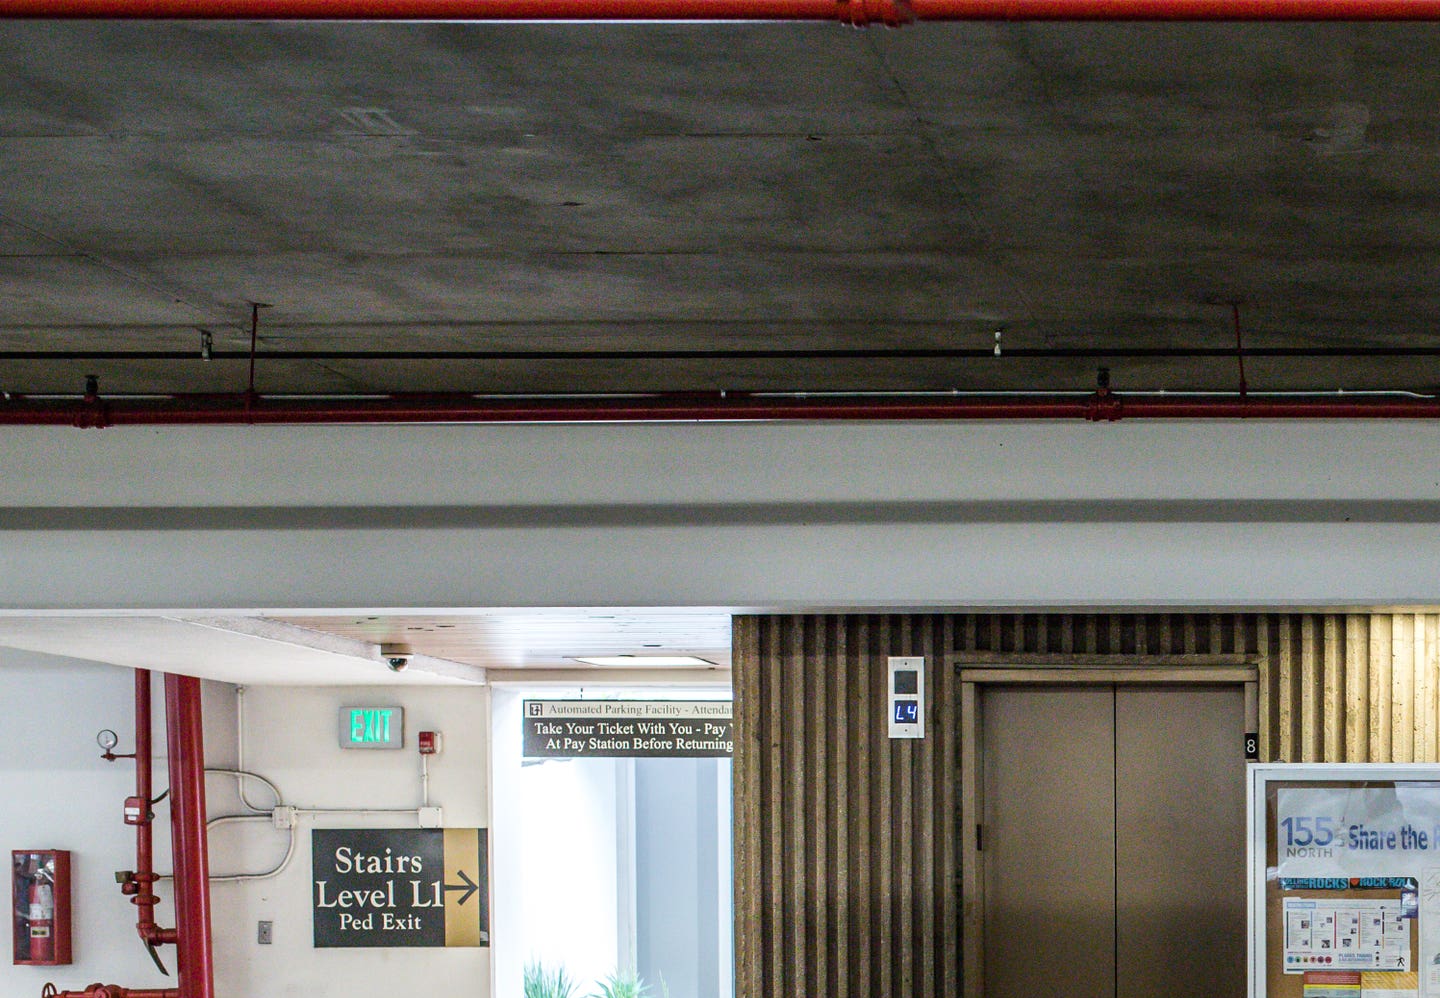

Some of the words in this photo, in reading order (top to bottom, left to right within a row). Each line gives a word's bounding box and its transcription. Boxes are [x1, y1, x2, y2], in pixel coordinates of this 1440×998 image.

[550, 704, 602, 714] Automated
[605, 704, 642, 717] Parking
[645, 704, 681, 717] Facility
[896, 705, 917, 720] L4
[351, 709, 392, 742] EXIT
[534, 723, 563, 734] Take
[566, 723, 595, 734] Your
[597, 723, 634, 734] Ticket
[637, 723, 666, 734] With
[669, 723, 693, 734] You
[704, 723, 726, 737] Pay
[546, 738, 560, 749] At
[564, 738, 586, 753] Pay
[589, 737, 630, 749] Station
[633, 737, 673, 749] Before
[676, 737, 733, 752] Returning
[1247, 739, 1256, 752] 8
[1281, 816, 1333, 846] 155
[1348, 825, 1396, 850] Share
[1401, 825, 1428, 850] the
[335, 846, 423, 874] Stairs
[1286, 848, 1333, 858] NORTH
[1309, 878, 1347, 889] ROCKS
[315, 880, 396, 908] Level
[409, 880, 444, 908] L1
[339, 913, 374, 931] Ped
[382, 913, 421, 931] Exit
